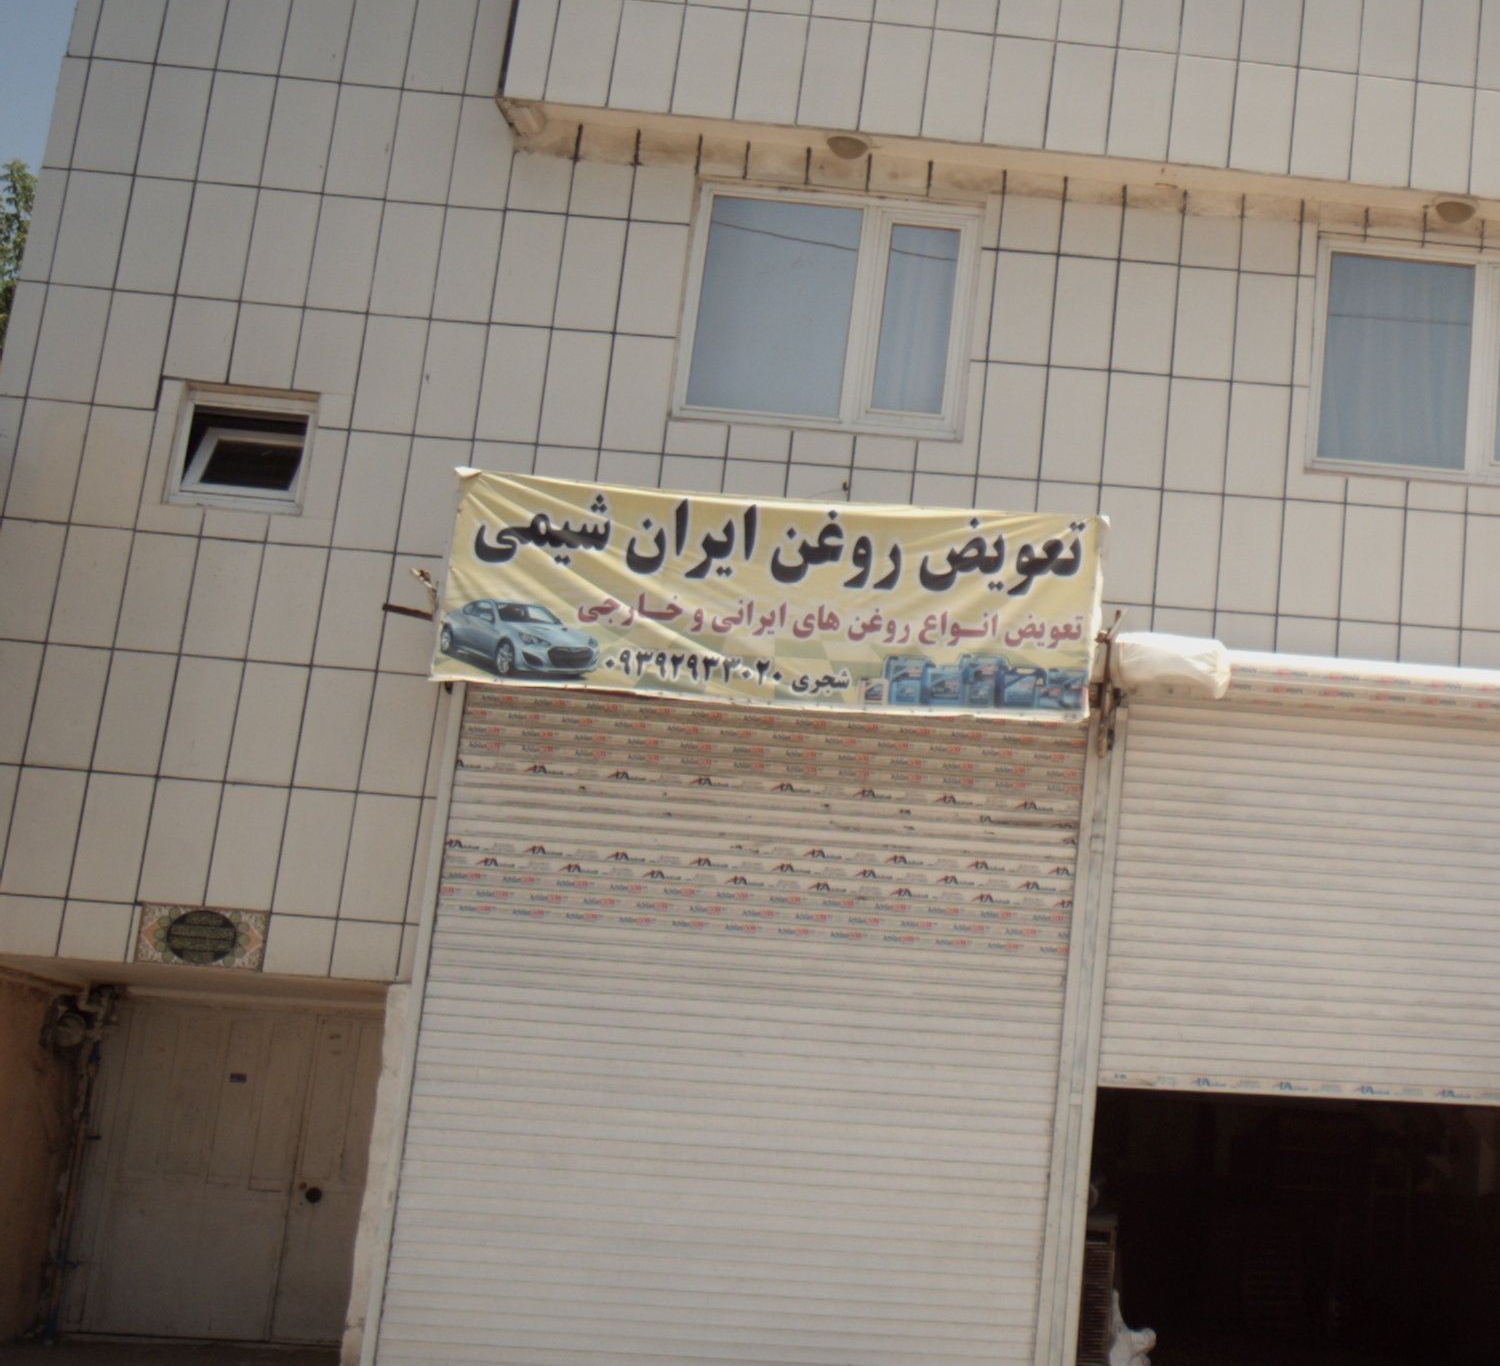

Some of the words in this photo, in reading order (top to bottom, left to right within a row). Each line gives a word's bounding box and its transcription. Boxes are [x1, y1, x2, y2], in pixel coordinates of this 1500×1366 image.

[474, 494, 611, 566] شیمی
[625, 498, 757, 579] ایران
[770, 509, 902, 590] روغن
[919, 517, 1086, 596] تعویض
[577, 592, 684, 627] خارجی
[690, 607, 704, 633] و
[711, 599, 787, 636] ایرانی
[792, 604, 841, 638] های
[848, 608, 911, 644] روغن
[1004, 614, 1084, 649] تعویض
[605, 649, 783, 685] ۰۹۳۹۲۹۳۳۰۲۰
[791, 670, 850, 694] شجری
